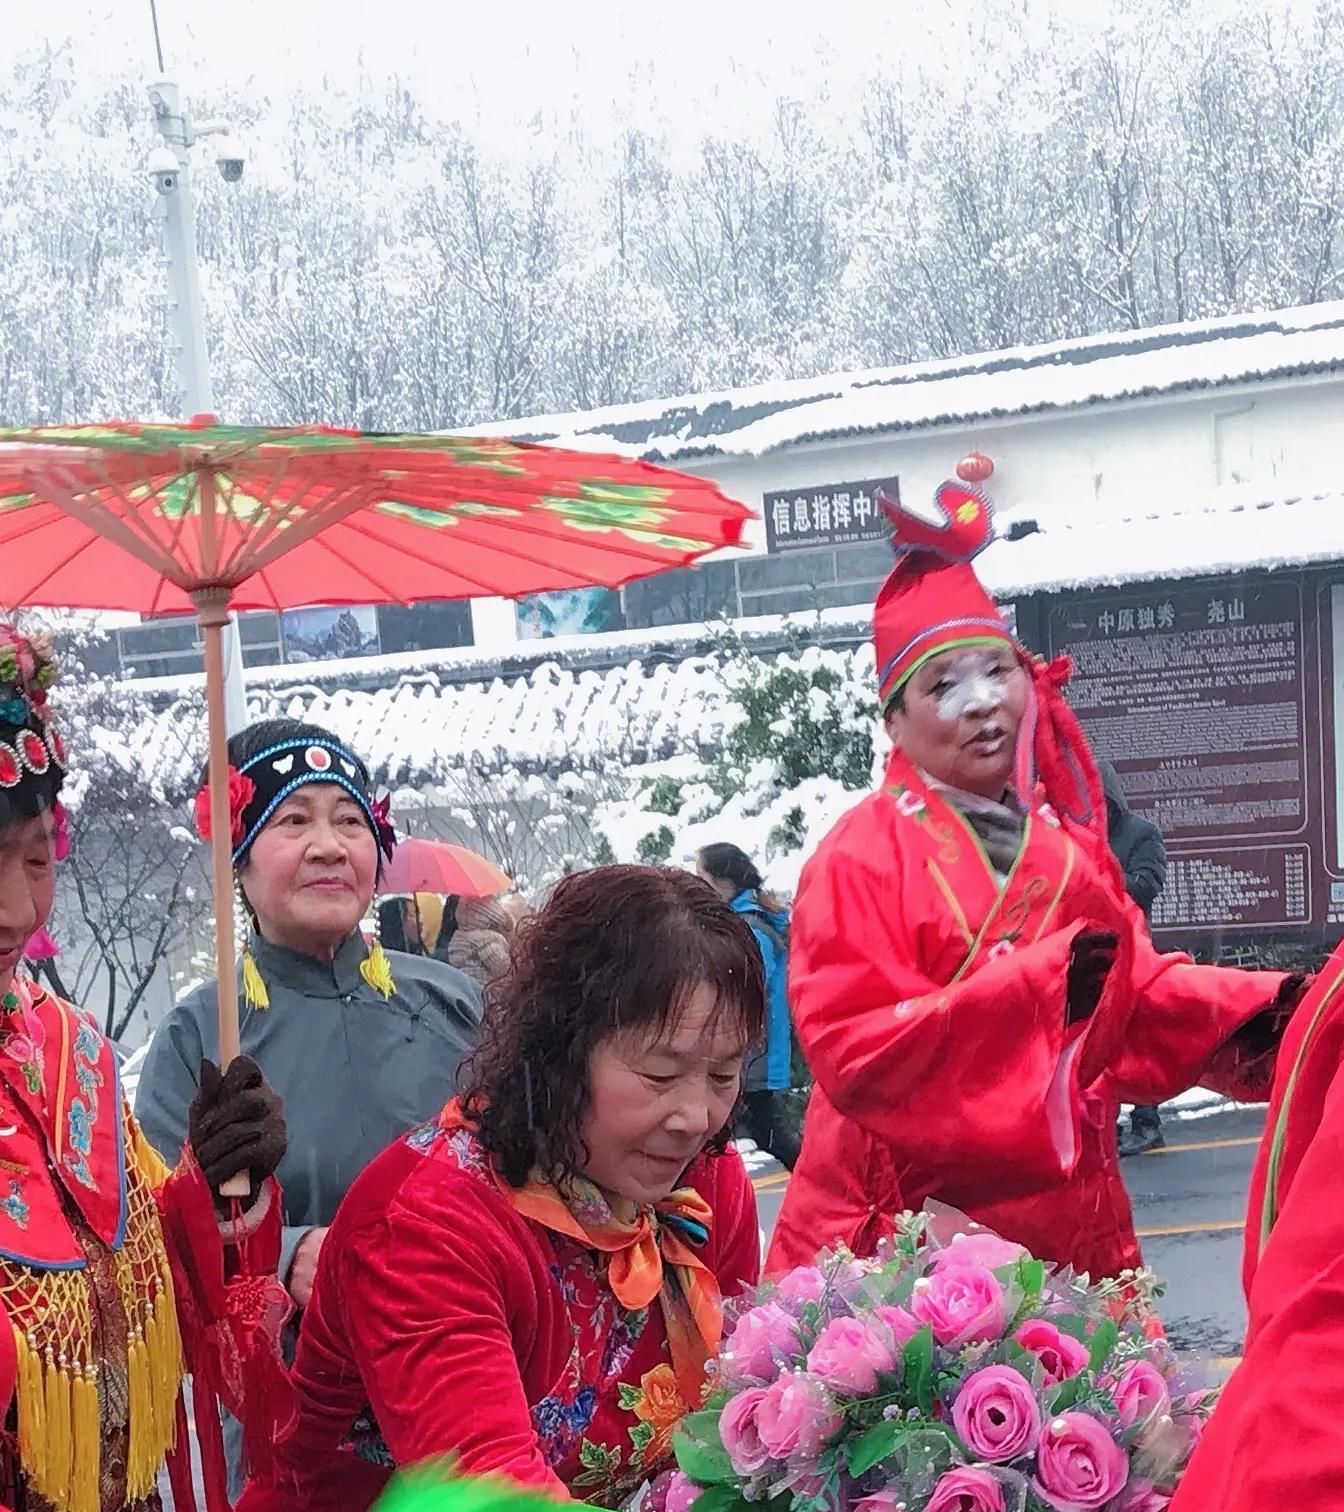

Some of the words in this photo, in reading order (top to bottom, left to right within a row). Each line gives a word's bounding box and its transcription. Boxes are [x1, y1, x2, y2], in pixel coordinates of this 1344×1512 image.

[772, 490, 879, 535] 信息指挥中
